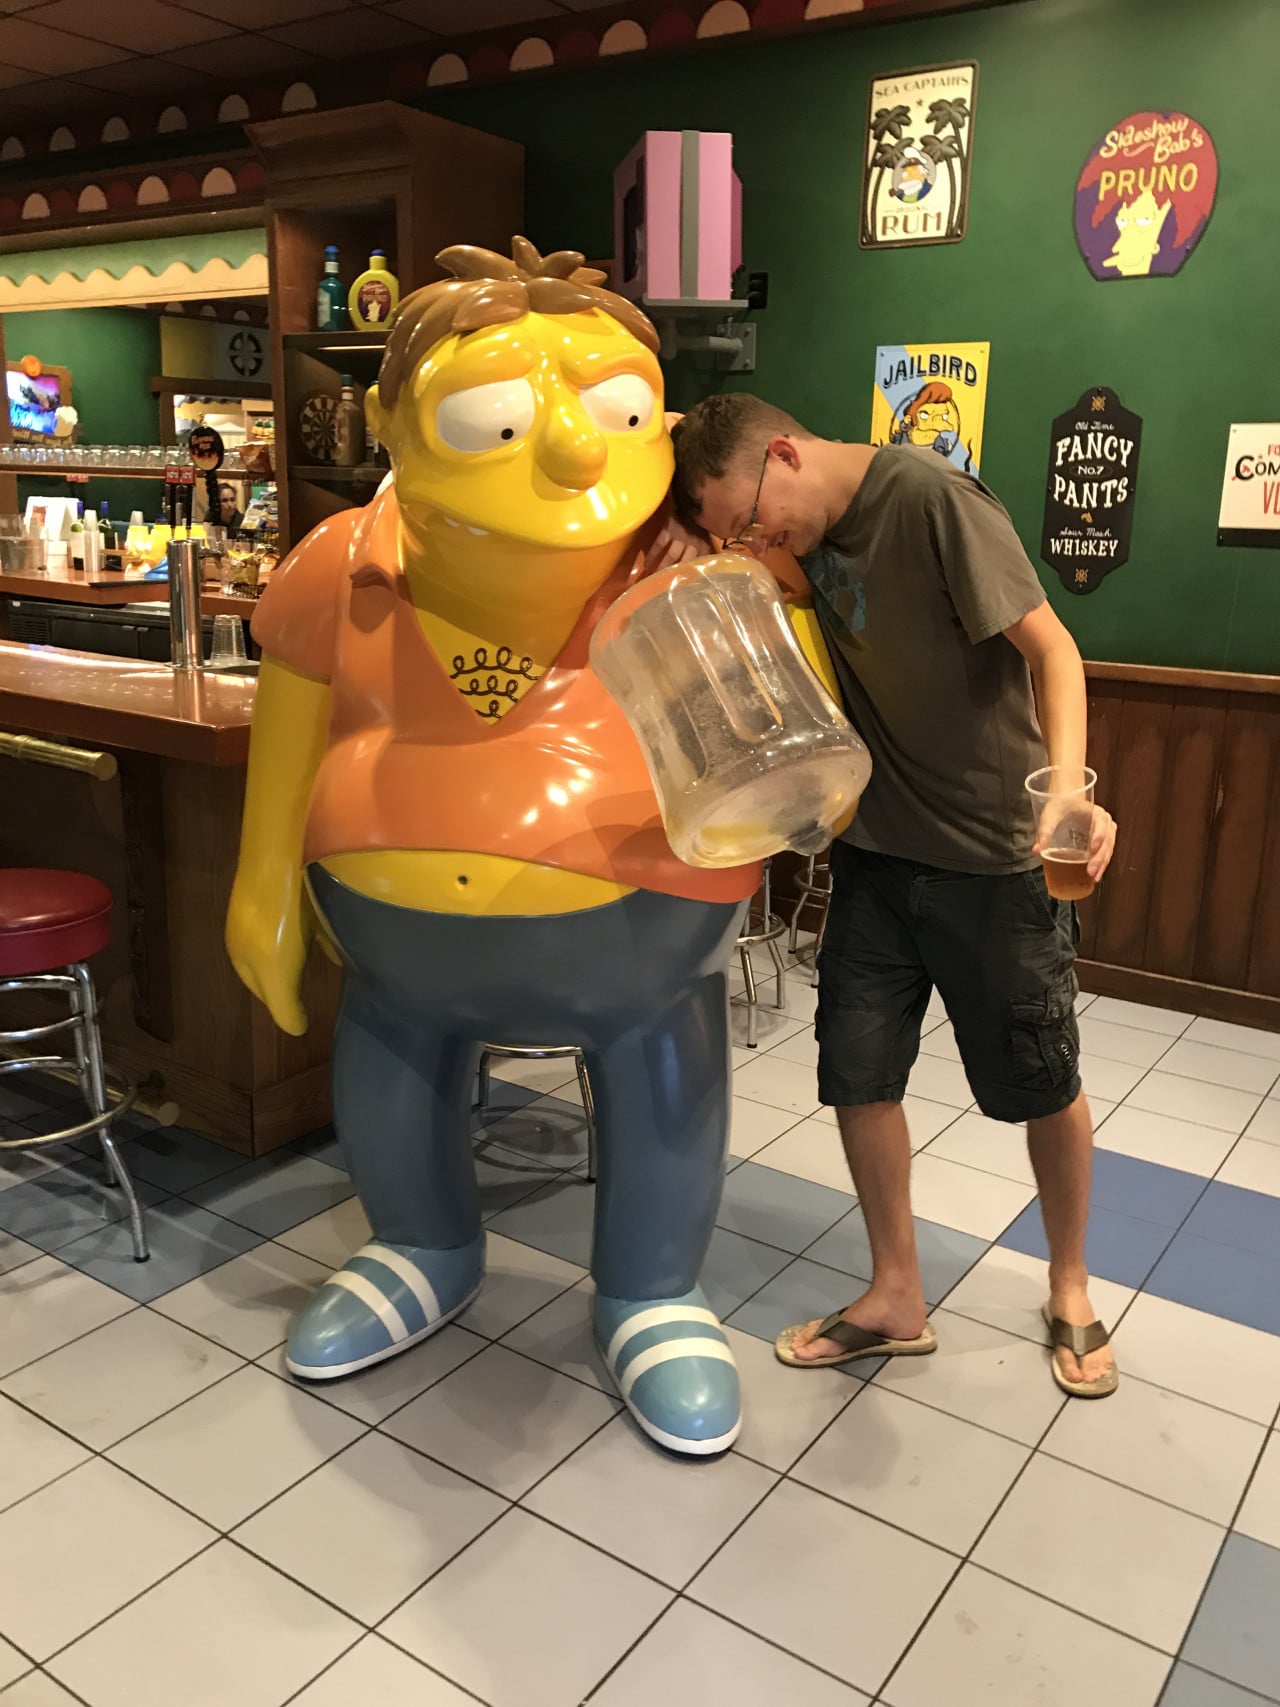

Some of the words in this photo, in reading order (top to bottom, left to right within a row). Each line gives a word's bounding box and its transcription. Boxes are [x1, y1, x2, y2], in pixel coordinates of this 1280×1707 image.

[875, 85, 900, 98] SEA
[1099, 118, 1189, 158] Sideshow
[1098, 162, 1198, 201] PRUNO
[881, 212, 942, 236] RUM
[883, 353, 978, 389] JAILBIRD
[1055, 431, 1134, 468] FANCY
[1053, 473, 1129, 509] PANTS
[1050, 538, 1119, 557] WHISKEY
